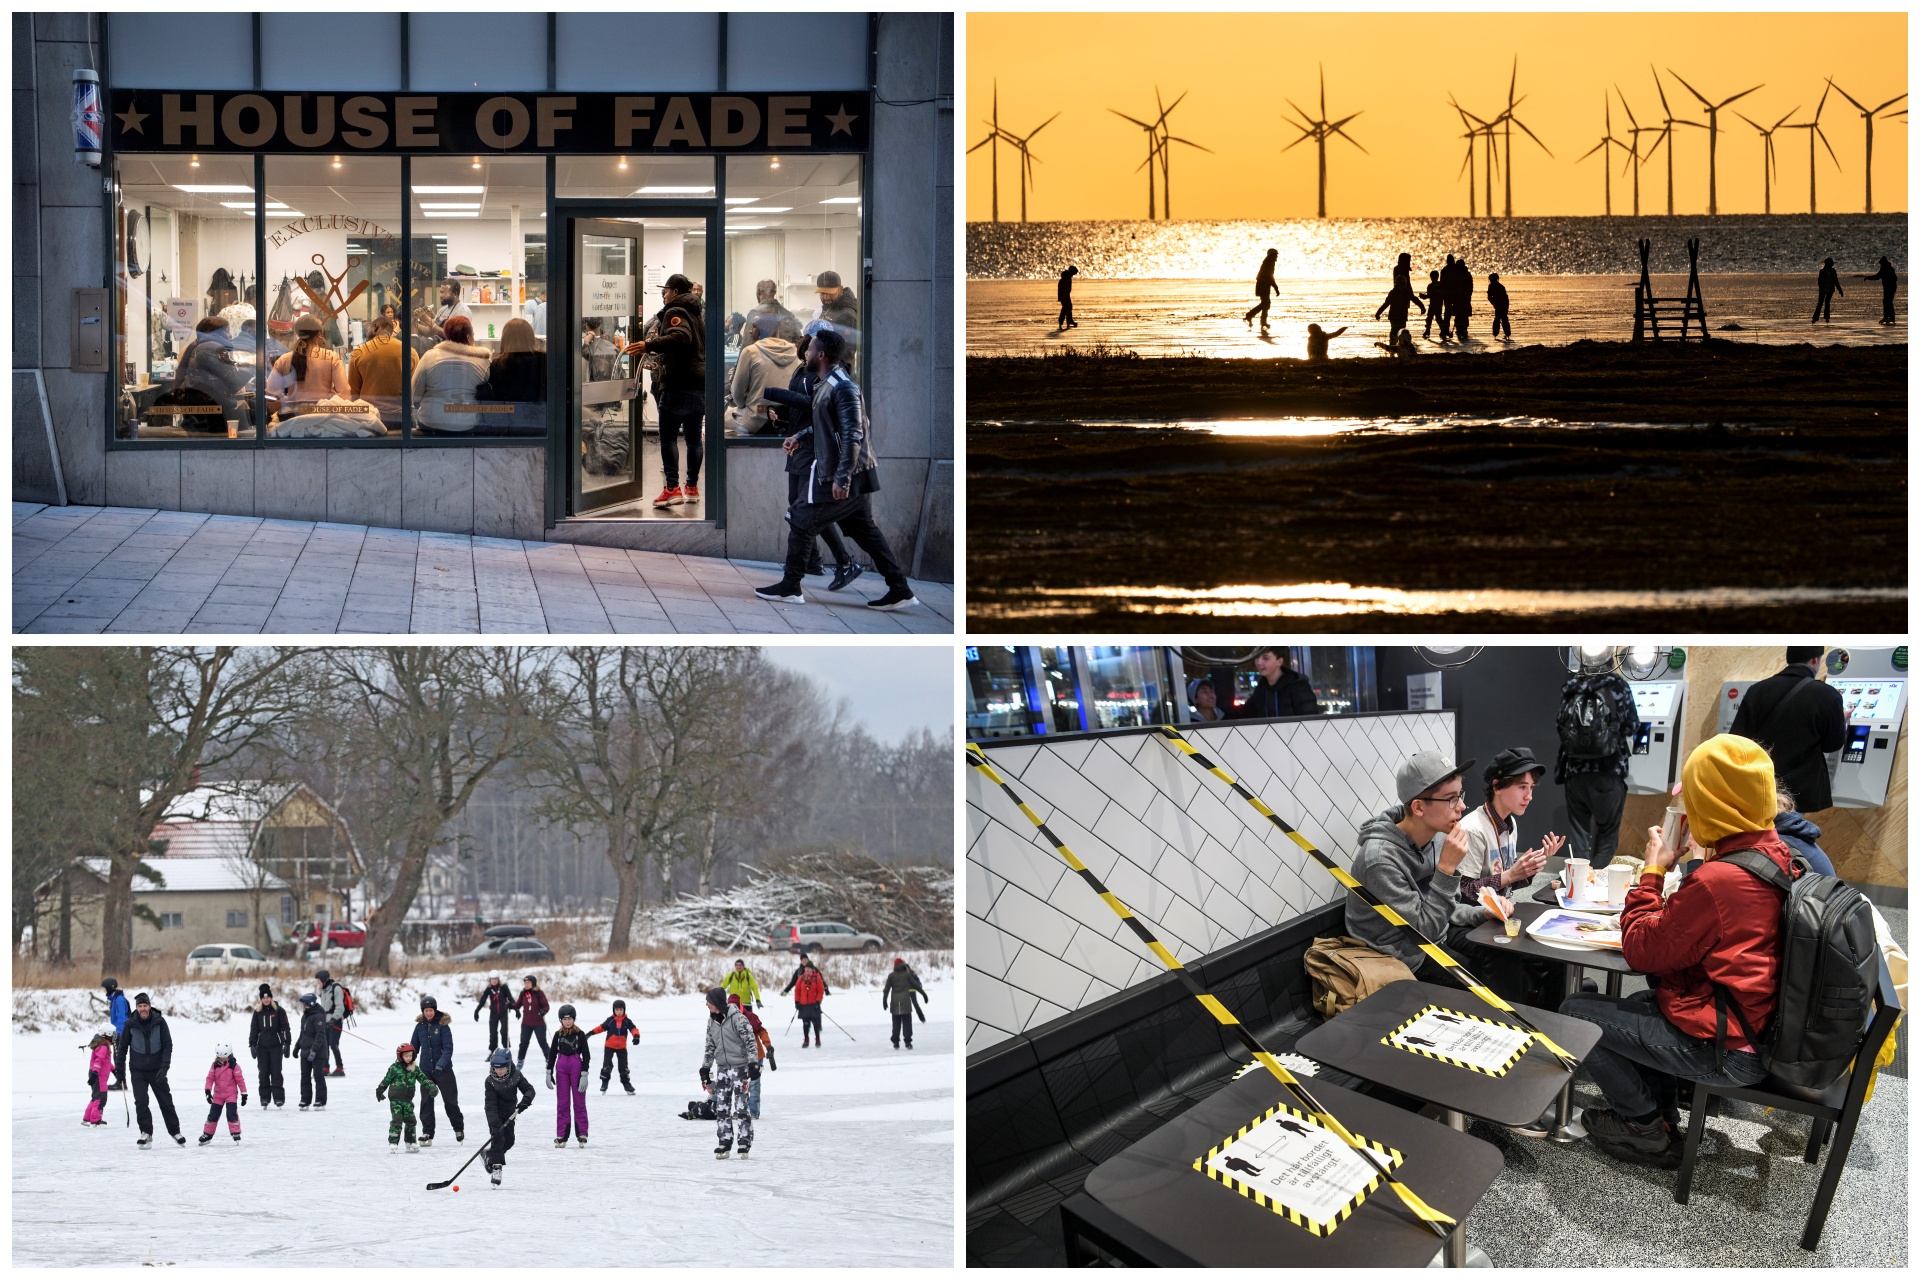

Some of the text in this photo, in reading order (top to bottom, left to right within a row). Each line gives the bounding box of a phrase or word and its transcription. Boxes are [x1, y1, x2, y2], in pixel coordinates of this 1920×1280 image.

[162, 93, 812, 149] HOUSE OF FADE
[267, 213, 400, 251] EXCLUSIVE
[1270, 1171, 1290, 1186] Det
[1286, 1160, 1303, 1173] här
[1300, 1140, 1330, 1162] bordet
[1287, 1176, 1300, 1186] är
[1297, 1148, 1334, 1178] tillfälligt
[1303, 1157, 1341, 1188] avstängt.
